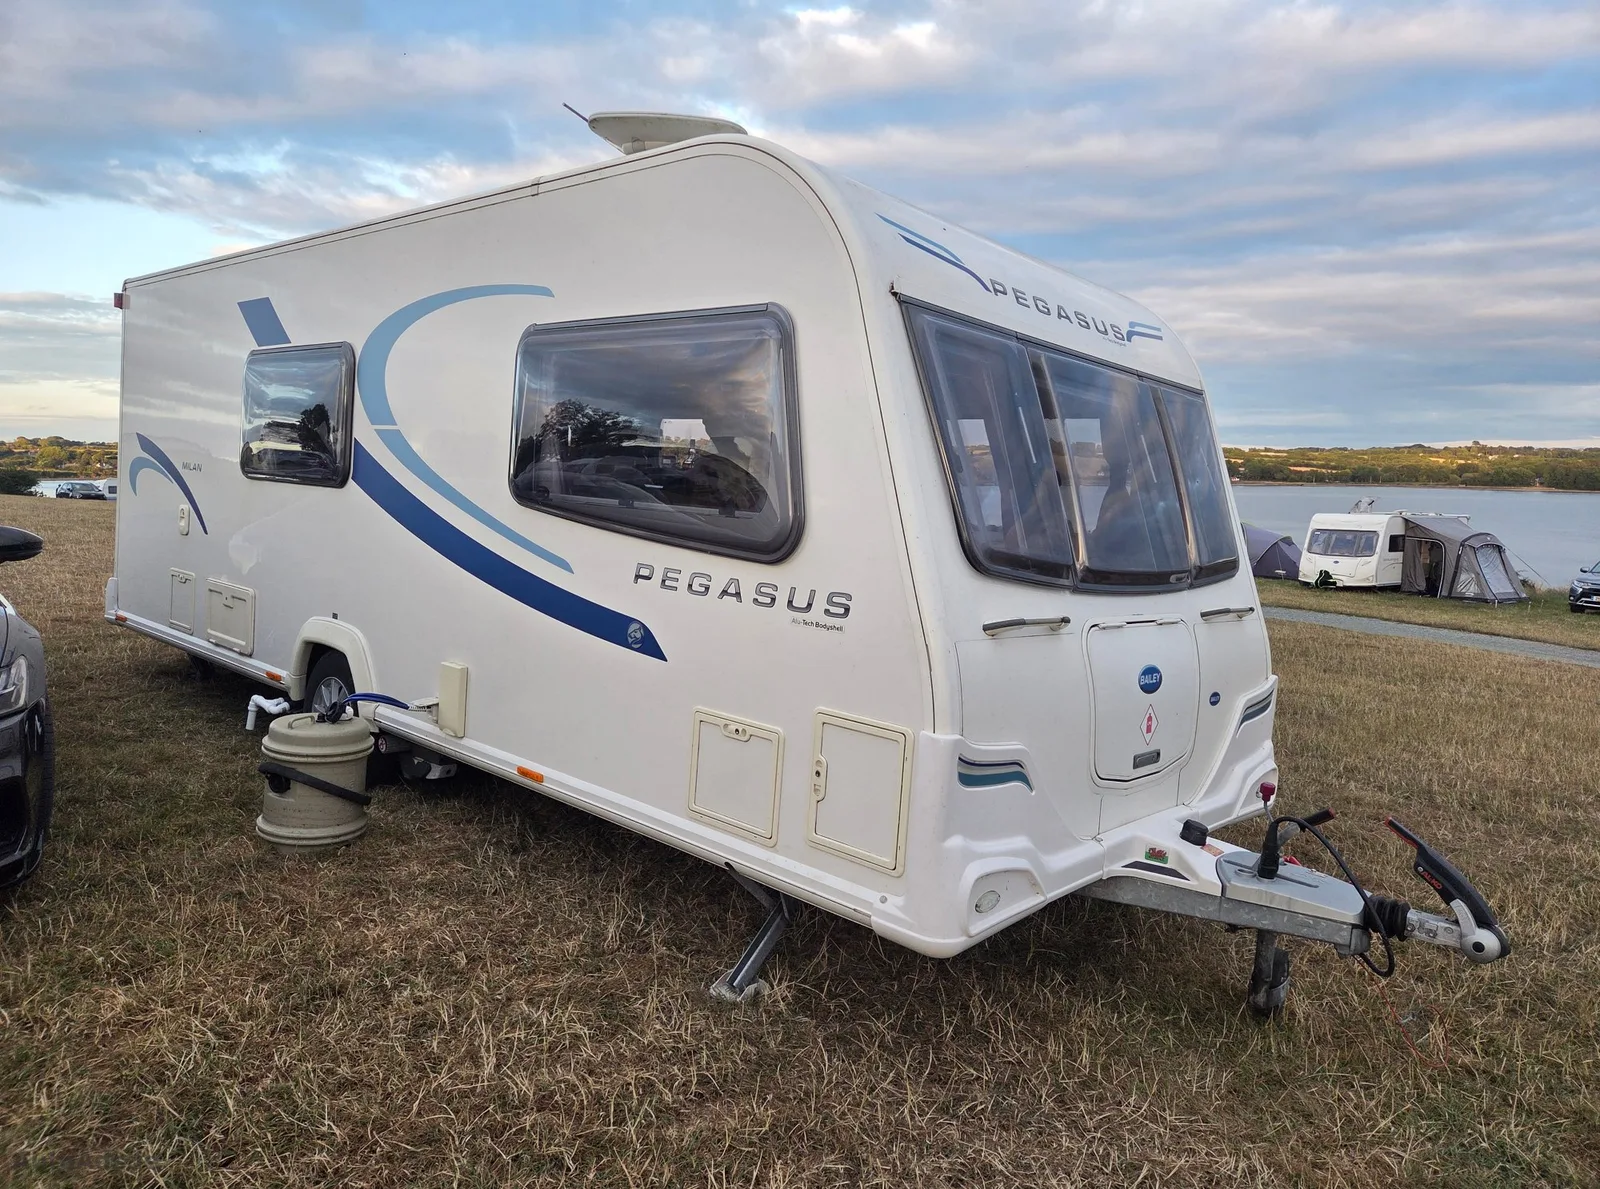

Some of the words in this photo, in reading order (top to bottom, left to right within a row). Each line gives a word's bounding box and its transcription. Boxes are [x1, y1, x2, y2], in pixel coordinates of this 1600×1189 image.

[989, 278, 1126, 342] PEGASUS
[182, 462, 203, 472] MILAN
[633, 562, 853, 619] PEGASUS
[791, 618, 814, 627] Alu-Tech
[815, 622, 844, 632] Bodyshell
[1140, 673, 1161, 685] BAILEY
